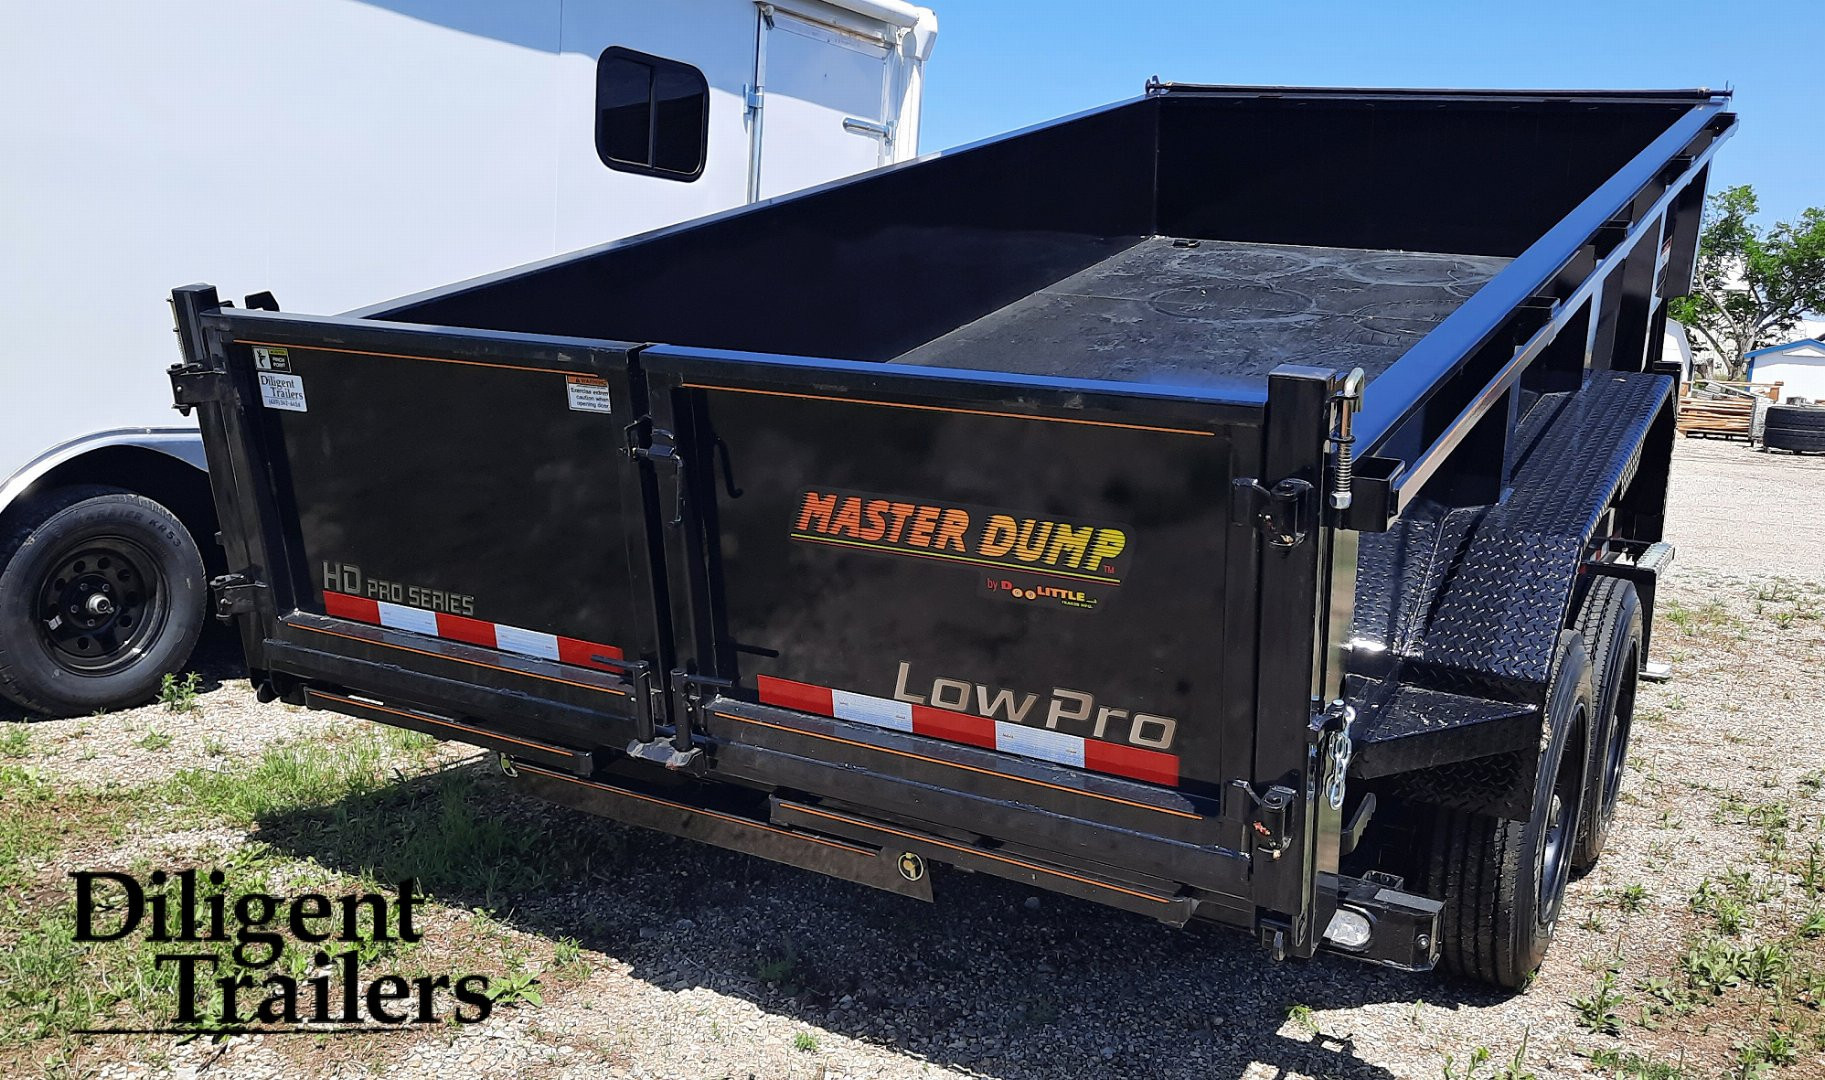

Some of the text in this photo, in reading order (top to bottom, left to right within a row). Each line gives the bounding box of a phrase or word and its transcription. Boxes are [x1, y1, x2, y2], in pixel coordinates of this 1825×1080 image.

[260, 375, 295, 390] Diligent
[270, 386, 304, 400] Trailers
[576, 401, 597, 409] opening
[78, 508, 144, 523] ARRIER
[794, 491, 970, 553] MASTER
[976, 513, 1127, 572] DUMP
[322, 560, 475, 616] HD PRO SERIES
[987, 578, 998, 592] by
